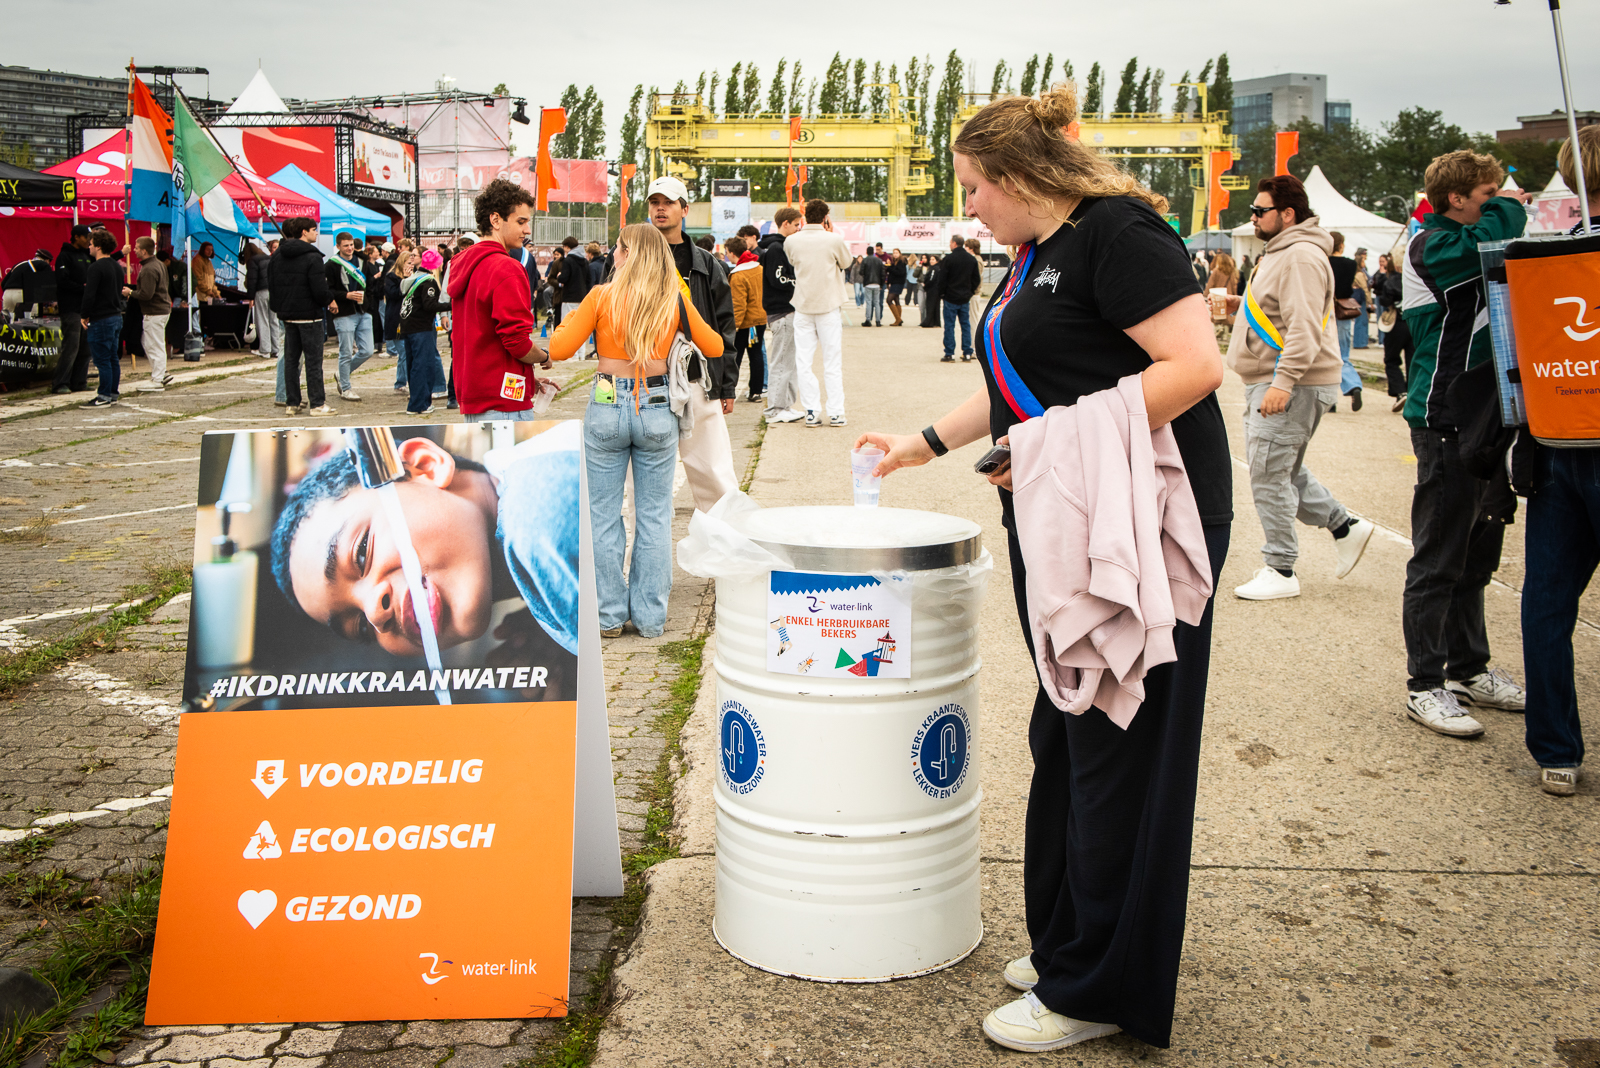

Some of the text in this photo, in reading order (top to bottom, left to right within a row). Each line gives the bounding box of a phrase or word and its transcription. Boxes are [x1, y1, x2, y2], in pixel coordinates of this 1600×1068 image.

[419, 168, 444, 185] NCE
[276, 203, 317, 217] SPORTSTICKER
[903, 229, 935, 238] Burgers
[1561, 387, 1583, 396] zeker
[785, 615, 890, 628] ENKEL HERBRUIKBARE
[821, 628, 857, 638] BEKERS
[209, 666, 549, 699] #IKDRINKKRAANWATER
[910, 703, 972, 759] VERS KRAANTJESWATER
[299, 758, 484, 788] VOORDELIG
[729, 783, 738, 794] EN
[739, 766, 765, 795] GEZOND
[912, 752, 971, 799] LEKKER EN GEZOND
[289, 823, 497, 853] ECOLOGISCH
[285, 893, 422, 922] GEZOND
